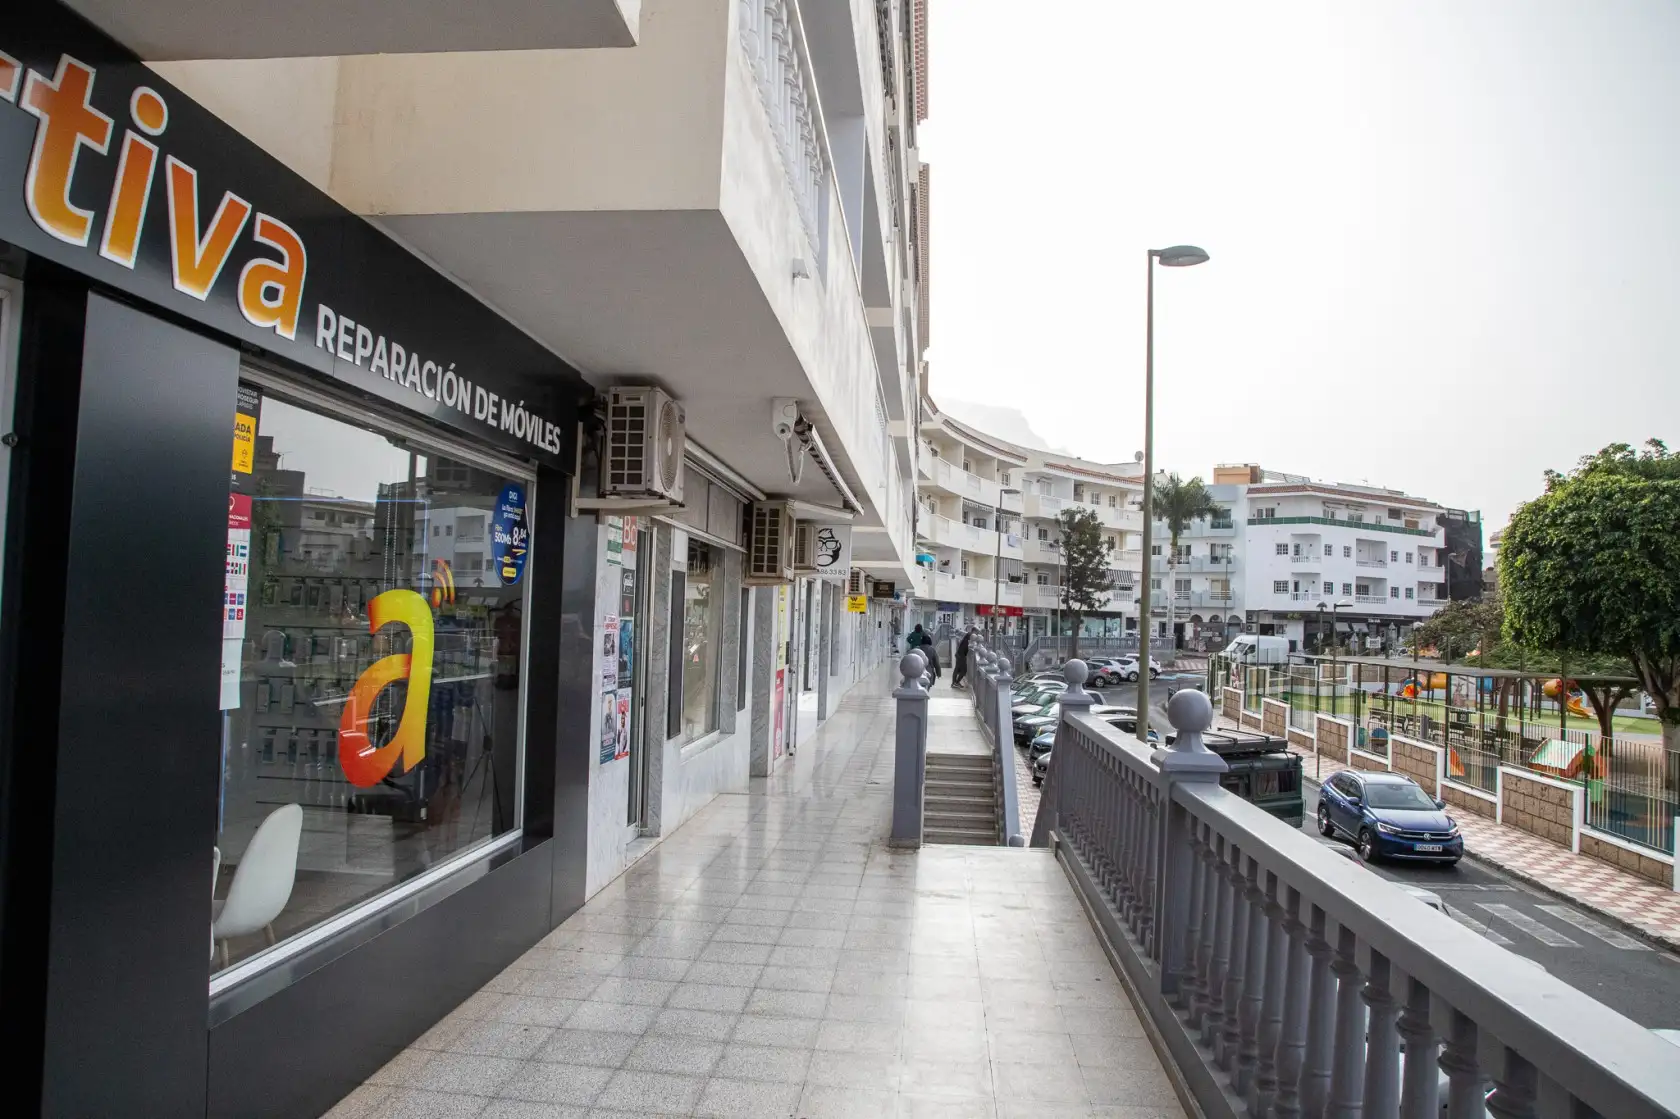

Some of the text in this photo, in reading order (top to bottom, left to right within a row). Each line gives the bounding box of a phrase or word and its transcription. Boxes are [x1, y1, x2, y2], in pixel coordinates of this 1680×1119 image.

[0, 50, 308, 342] tiva
[316, 303, 561, 455] REPARACIÓN DE MÓVILES
